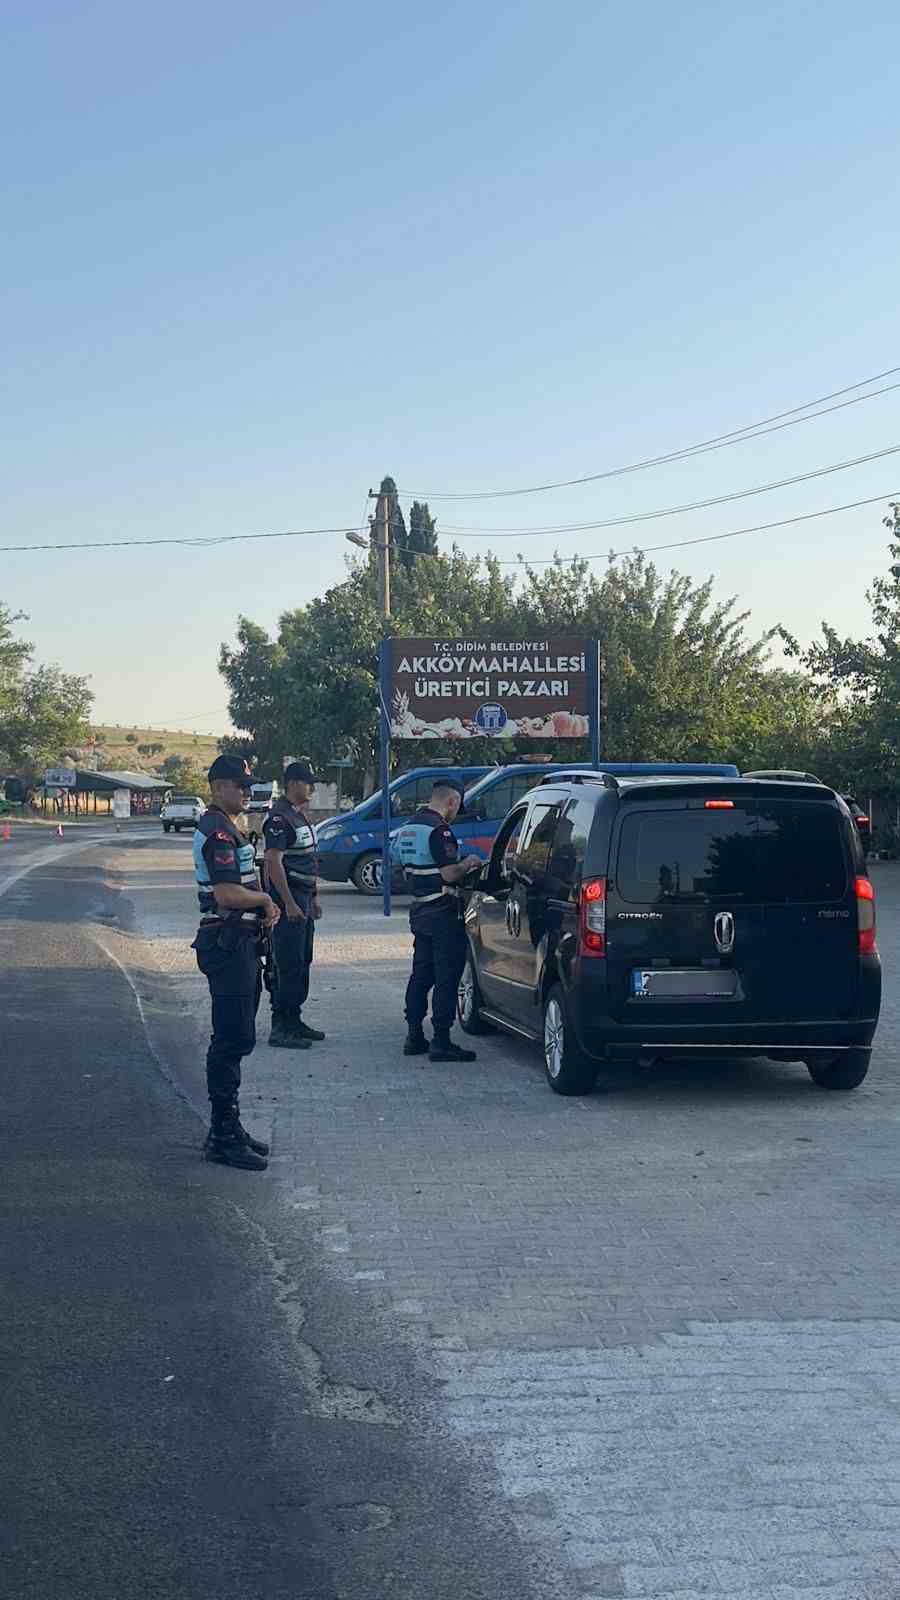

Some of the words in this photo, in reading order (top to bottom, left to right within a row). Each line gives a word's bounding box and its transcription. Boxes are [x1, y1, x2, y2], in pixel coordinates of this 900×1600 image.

[433, 643, 453, 652] T.C.
[456, 642, 487, 651] DİDİM
[490, 642, 549, 651] BELEDİYESİ
[397, 653, 465, 673] AKKÖY
[469, 653, 585, 672] MAHALLESİ
[415, 677, 490, 697] ÜRETİCİ
[498, 680, 568, 696] PAZARI
